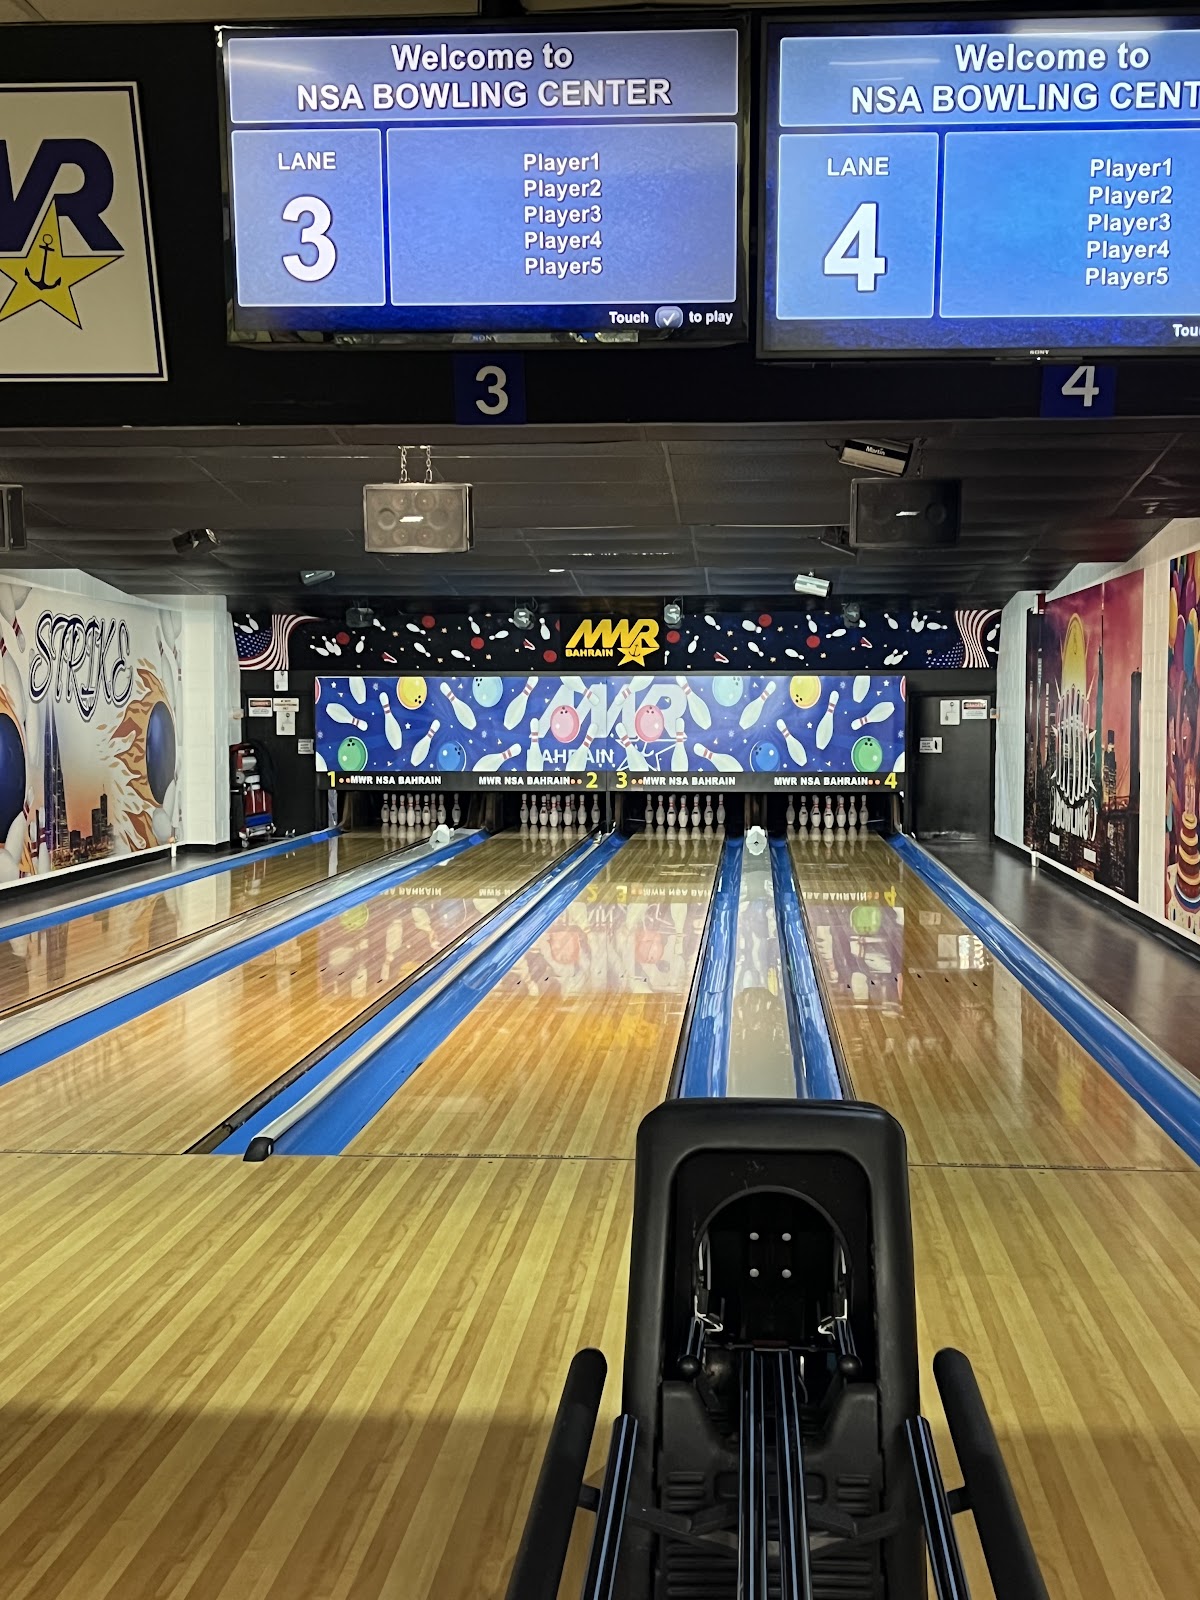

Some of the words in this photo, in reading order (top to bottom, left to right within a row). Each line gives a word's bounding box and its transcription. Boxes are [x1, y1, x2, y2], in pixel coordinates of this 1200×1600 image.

[391, 43, 534, 71] Welcome
[542, 42, 573, 69] to
[955, 43, 1106, 72] Welcome
[1117, 42, 1149, 70] to
[297, 84, 366, 112] NSA
[373, 80, 527, 110] BOWLING
[538, 78, 672, 107] CENTER
[851, 85, 924, 114] NSA
[932, 82, 1098, 113] BOWLING
[1110, 80, 1200, 110] CENT
[278, 151, 337, 170] LANE
[523, 152, 600, 176] Player1
[827, 156, 890, 176] LANE
[1090, 157, 1173, 182] Player1
[523, 178, 602, 202] Player2
[1089, 185, 1173, 210] Player2
[523, 204, 603, 228] Player3
[1088, 212, 1171, 236] Player3
[282, 194, 338, 282] 3
[524, 230, 603, 254] Player4
[823, 201, 888, 293] 4
[1086, 239, 1170, 264] Player4
[525, 256, 603, 280] Player5
[1085, 266, 1169, 290] Player5
[608, 310, 649, 324] Touch
[689, 310, 703, 323] to
[705, 310, 733, 326] play
[1172, 323, 1200, 338] Tou
[475, 365, 509, 415] 3
[1061, 365, 1100, 407] 4
[565, 618, 660, 649] MWR
[565, 648, 614, 658] BAHRAIN
[29, 610, 134, 723] STRIKE
[327, 770, 336, 788] 1
[350, 775, 373, 785] MWR
[375, 776, 396, 785] NSA
[398, 775, 442, 785] BAHRAIN
[478, 776, 502, 785] MWR
[504, 776, 524, 785] NSA
[526, 776, 570, 785] BAHRAIN
[585, 771, 599, 789] 2
[615, 771, 628, 789] 3
[643, 776, 667, 786] MWR
[668, 776, 689, 786] NSA
[691, 776, 736, 786] BAHRAIN
[774, 776, 798, 786] MWR
[800, 776, 821, 786] NSA
[823, 777, 868, 786] BAHRAIN
[884, 772, 898, 789] 4
[1055, 791, 1090, 841] BOWLING
